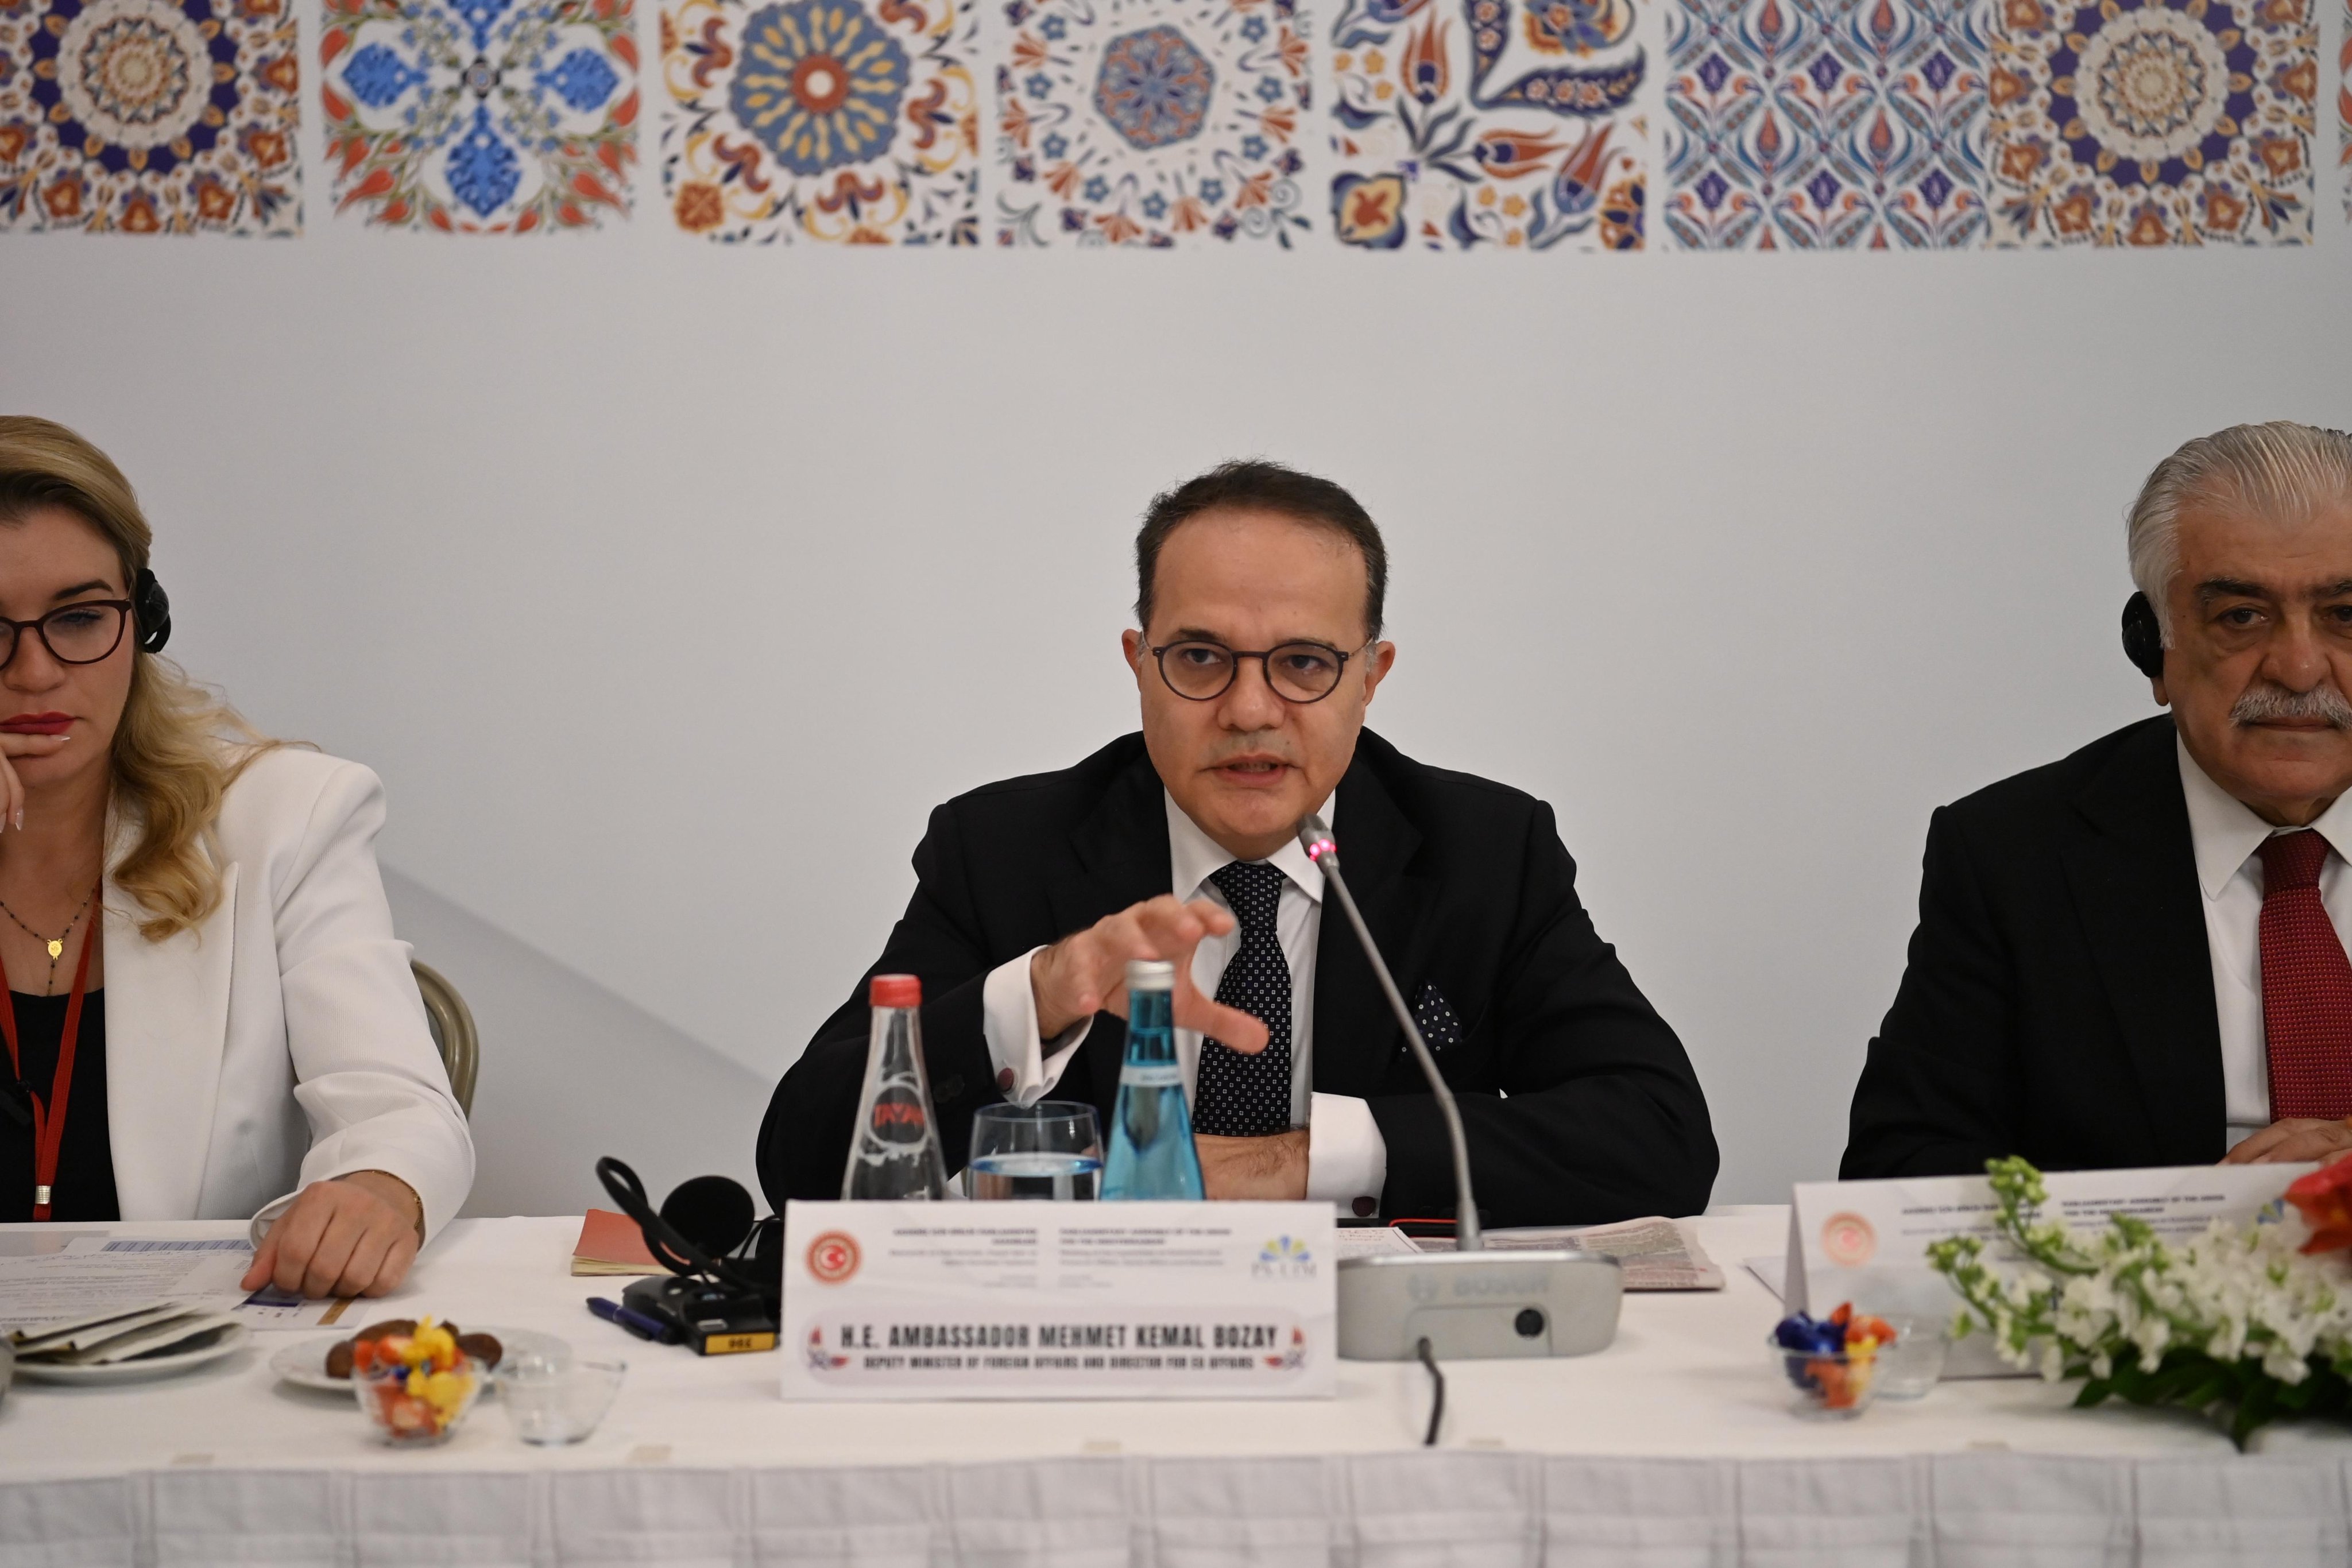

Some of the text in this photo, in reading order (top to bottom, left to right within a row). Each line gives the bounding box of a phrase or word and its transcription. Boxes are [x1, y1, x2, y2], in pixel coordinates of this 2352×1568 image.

[840, 1324, 1278, 1349] H.E. AMBASSADOR MEHMET KEMAL BOZAY
[862, 1356, 906, 1369] DEPUTY
[909, 1356, 962, 1369] MINISTER
[966, 1356, 980, 1369] OF
[983, 1356, 1030, 1369] FOREIGN
[1034, 1356, 1078, 1369] AFFAIRS
[1082, 1356, 1105, 1369] AND
[1109, 1356, 1163, 1369] DIRECTOR
[1166, 1356, 1188, 1369] FOR
[1208, 1356, 1254, 1369] AFFAIRS
